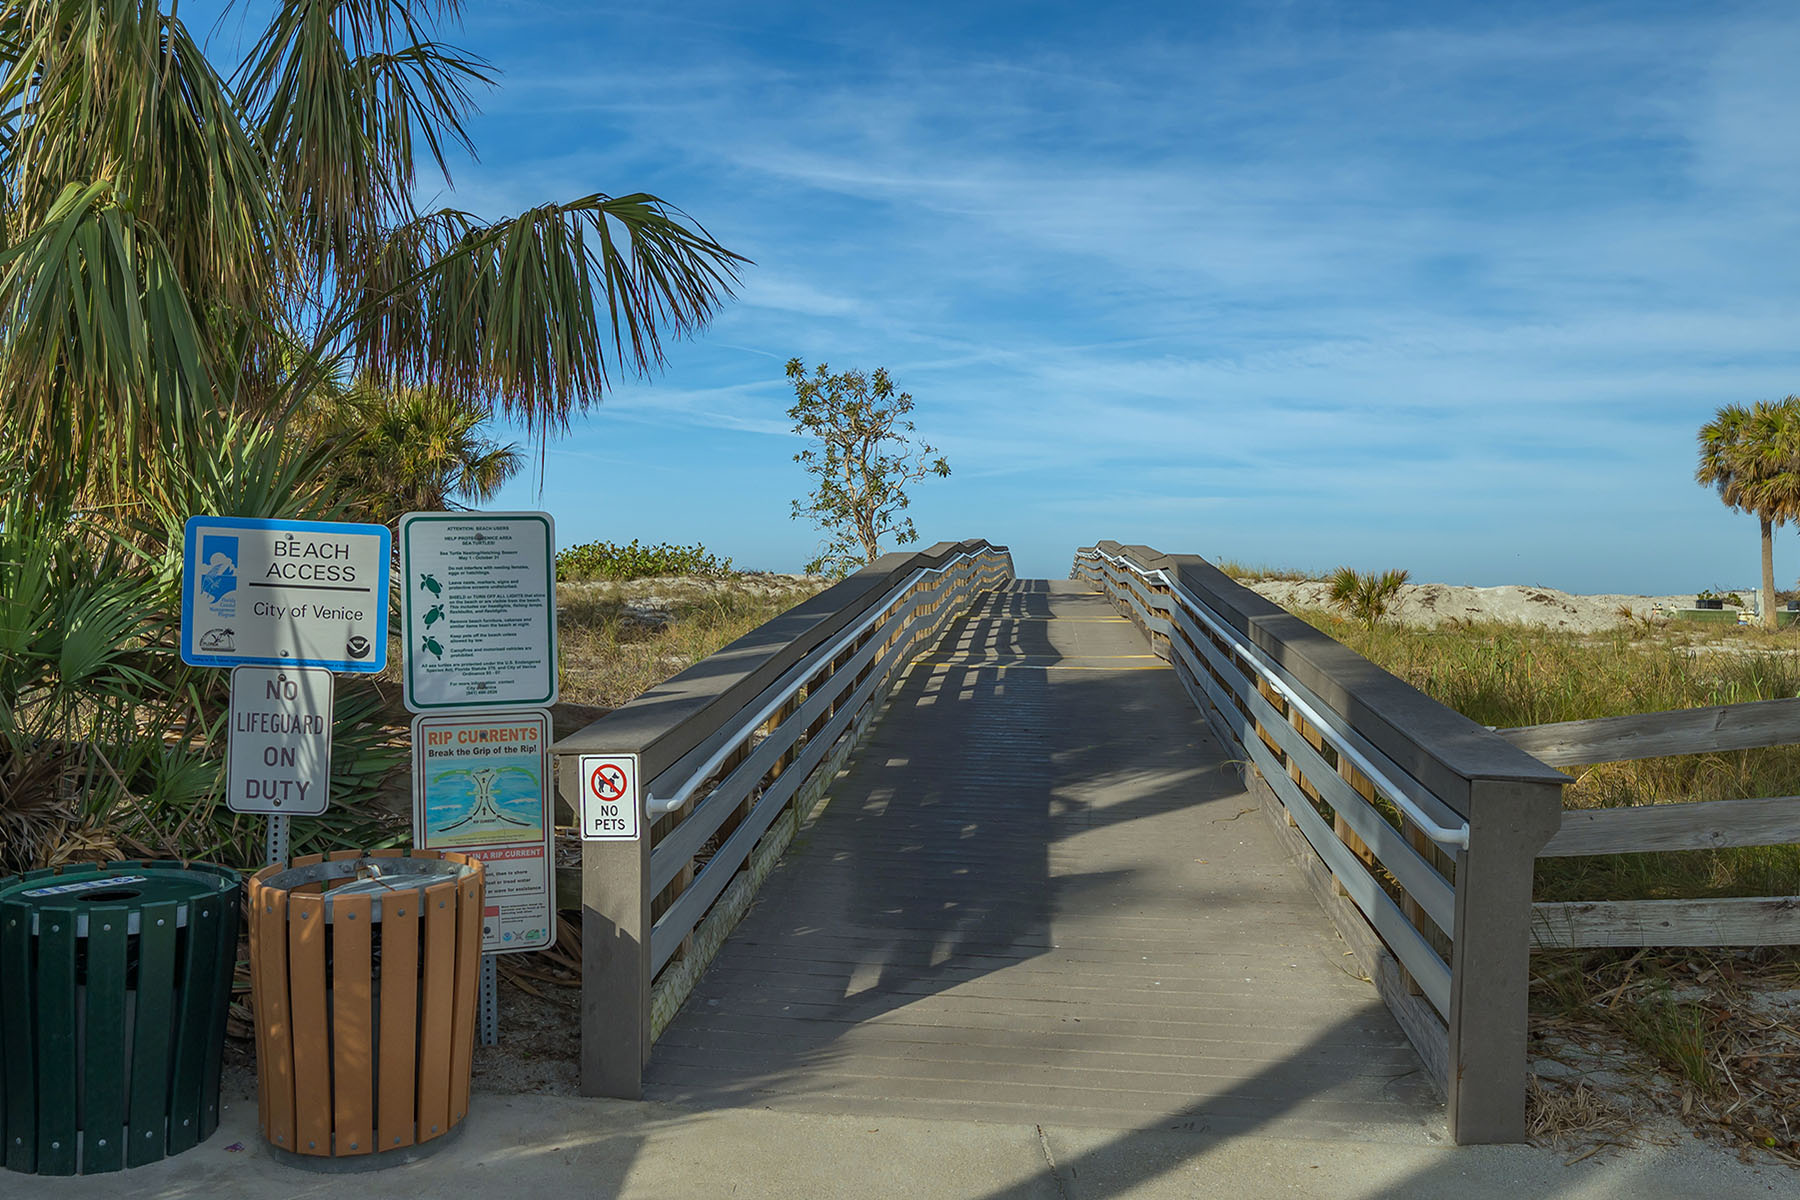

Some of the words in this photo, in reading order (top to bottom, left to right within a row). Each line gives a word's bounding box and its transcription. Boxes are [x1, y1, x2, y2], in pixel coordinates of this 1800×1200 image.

[275, 541, 349, 559] BEACH
[266, 563, 355, 582] ACCESS
[254, 602, 286, 620] City
[291, 604, 306, 618] of
[313, 605, 363, 621] Venice
[266, 681, 298, 701] NO
[238, 713, 324, 734] LIFEGUARD
[428, 731, 453, 745] RIP
[458, 727, 538, 744] CURRENTS
[264, 747, 295, 767] ON
[429, 749, 454, 757] Break
[473, 747, 491, 756] Grip
[504, 746, 518, 754] the
[520, 744, 537, 753] Rip!
[246, 780, 310, 800] DUTY
[601, 806, 618, 816] NO
[596, 819, 625, 830] PETS
[505, 849, 540, 857] CURRENT
